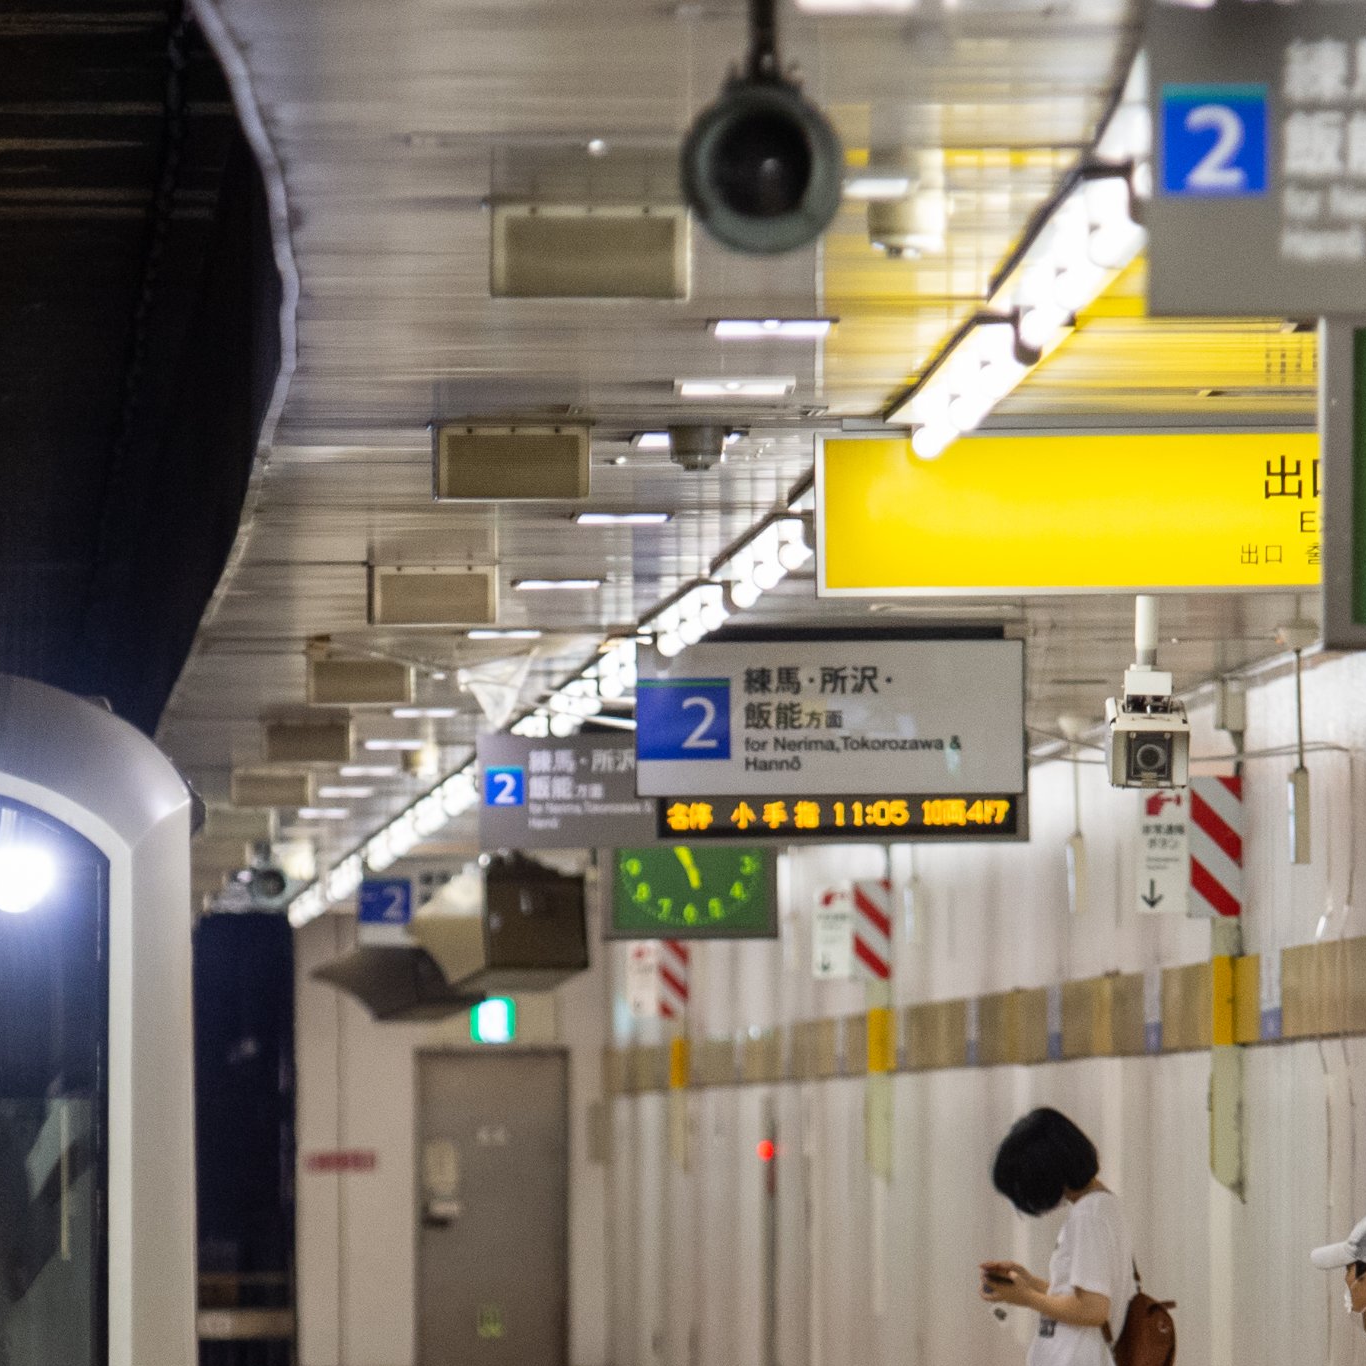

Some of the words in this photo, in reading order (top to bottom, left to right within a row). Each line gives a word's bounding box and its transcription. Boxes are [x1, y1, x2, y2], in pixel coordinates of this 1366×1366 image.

[1185, 103, 1246, 189] 2
[1264, 455, 1322, 499] 出
[1240, 543, 1283, 565] 出口
[681, 696, 719, 749] 2
[743, 702, 843, 730] 飯能方面
[744, 736, 767, 751] for
[949, 734, 961, 750] &
[493, 773, 517, 804] 2
[834, 800, 910, 827] 11:05
[383, 886, 407, 919] 2
